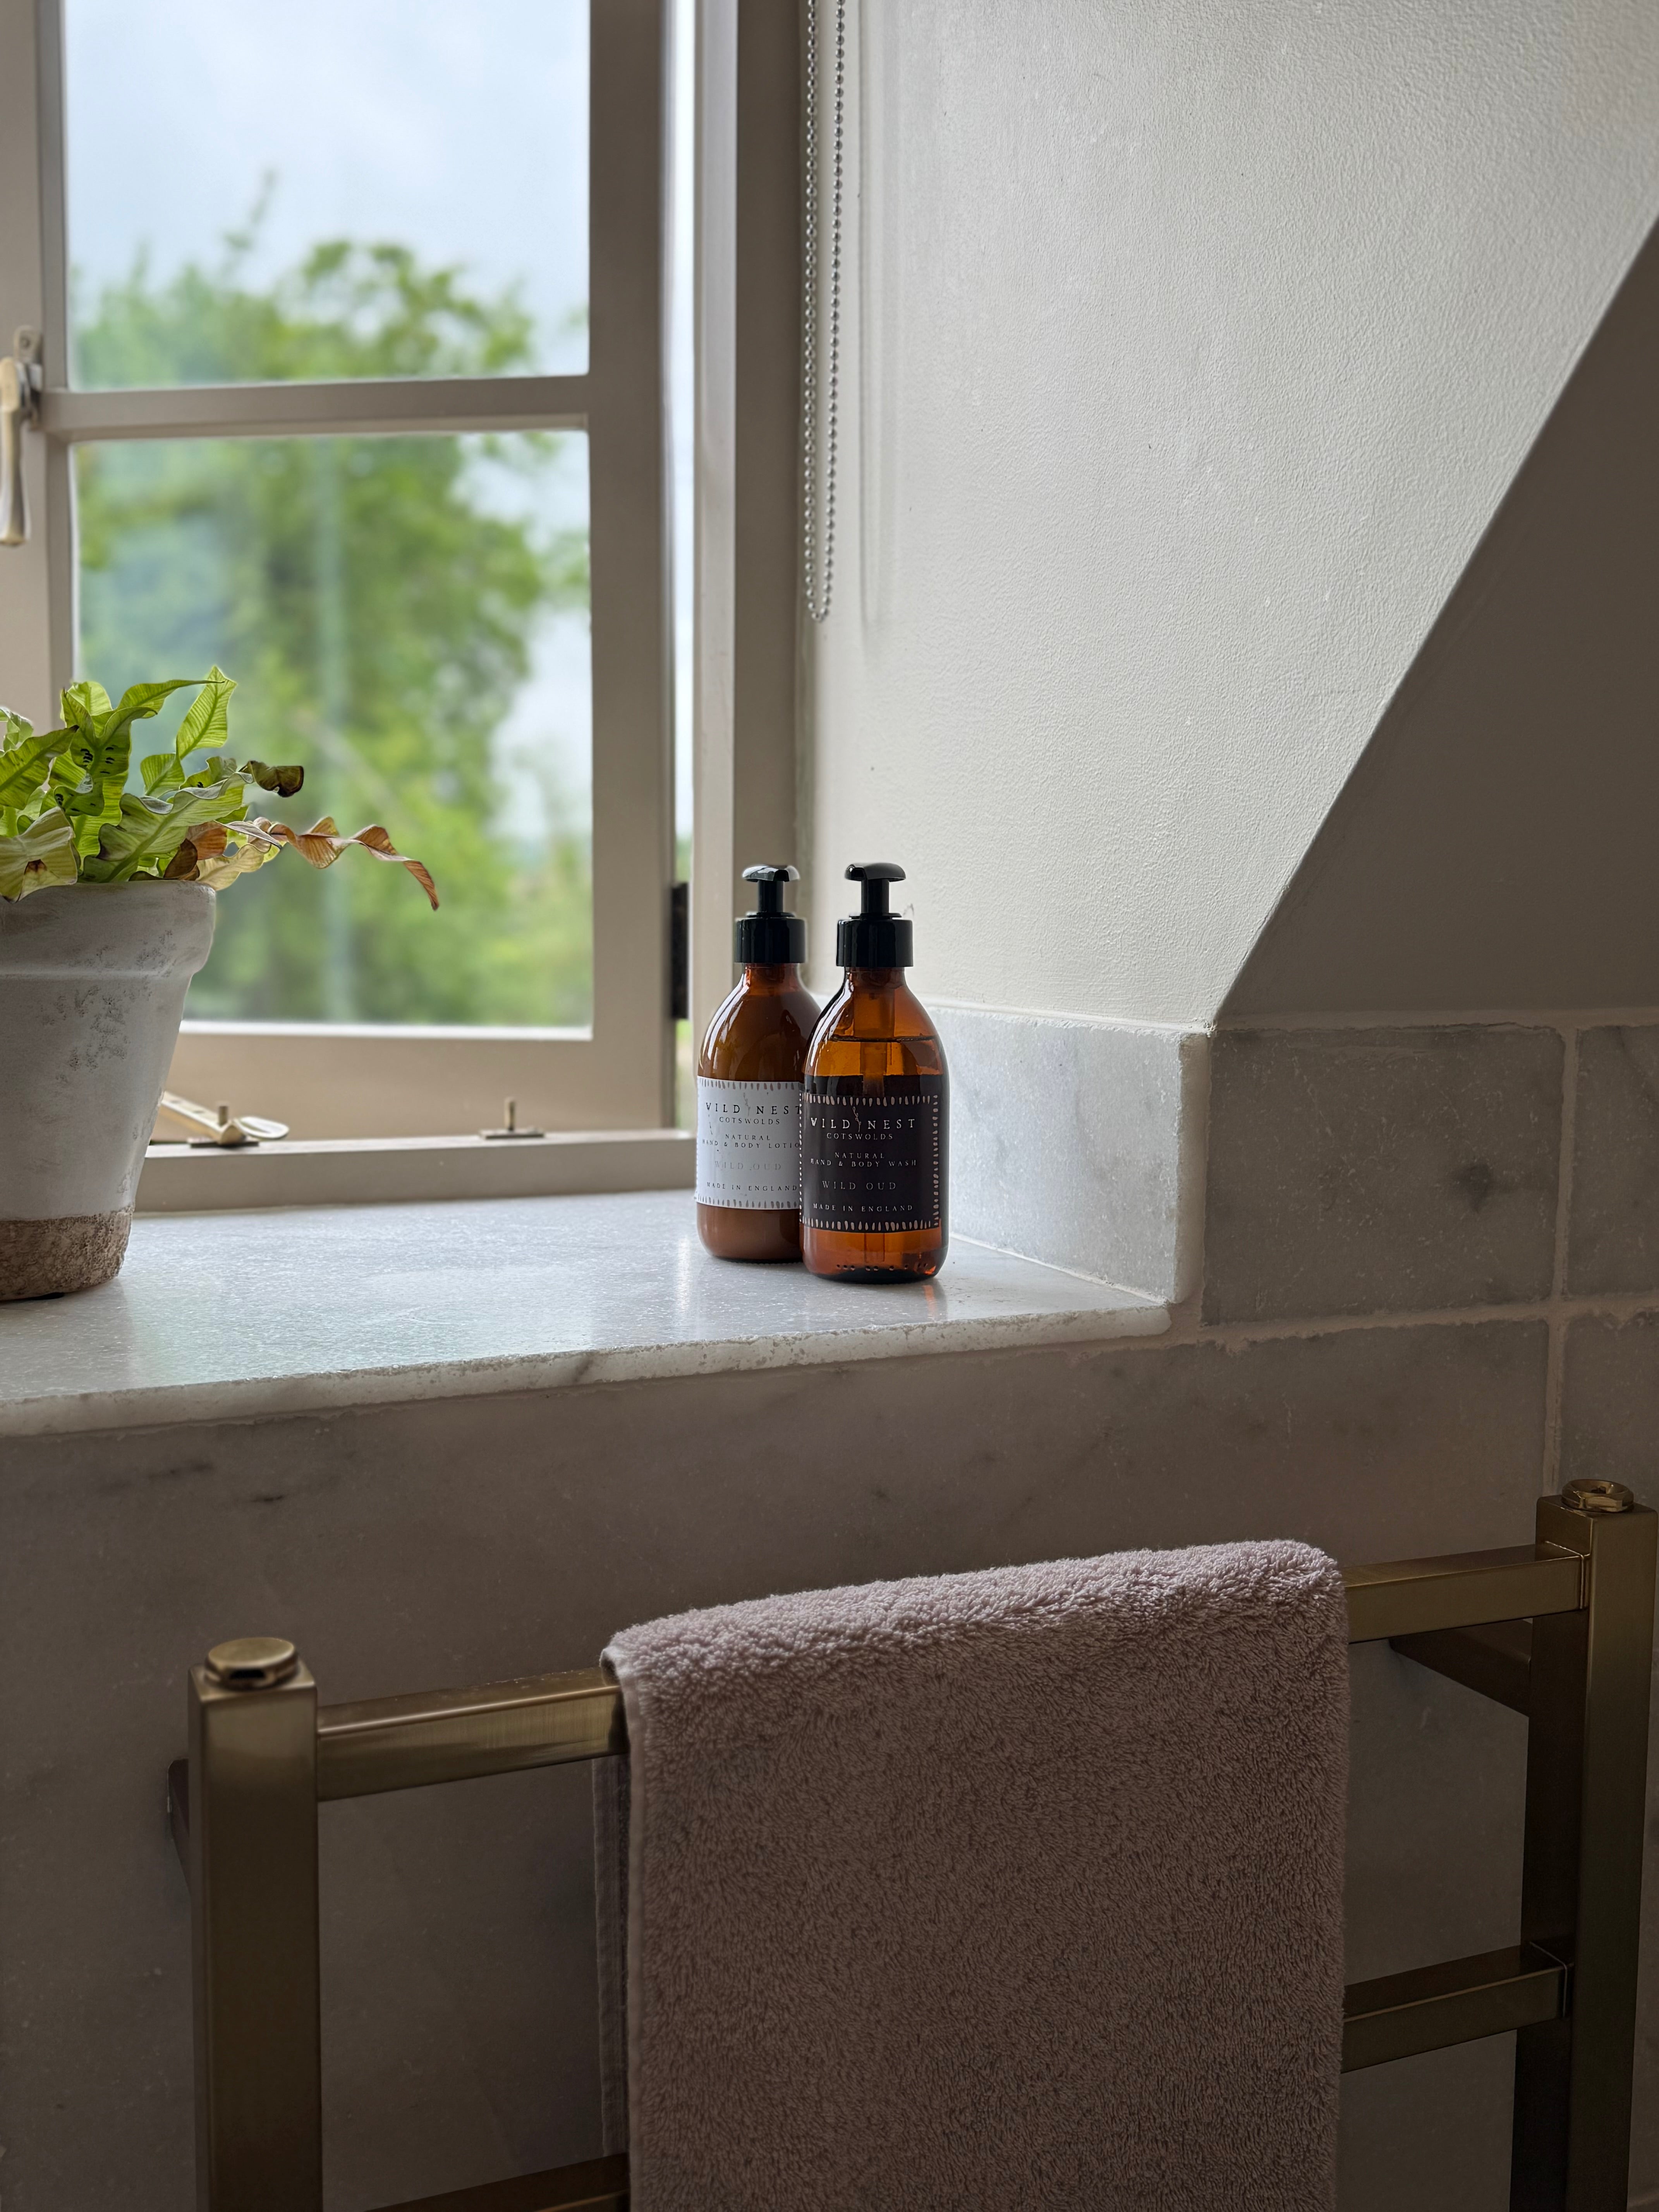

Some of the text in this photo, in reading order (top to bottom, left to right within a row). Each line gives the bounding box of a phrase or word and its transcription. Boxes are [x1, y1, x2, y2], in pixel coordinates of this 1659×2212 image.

[756, 1106, 801, 1115] NEST
[811, 1118, 915, 1129] WILD NEST
[715, 1161, 743, 1170] WILD
[822, 1181, 855, 1190] WILD
